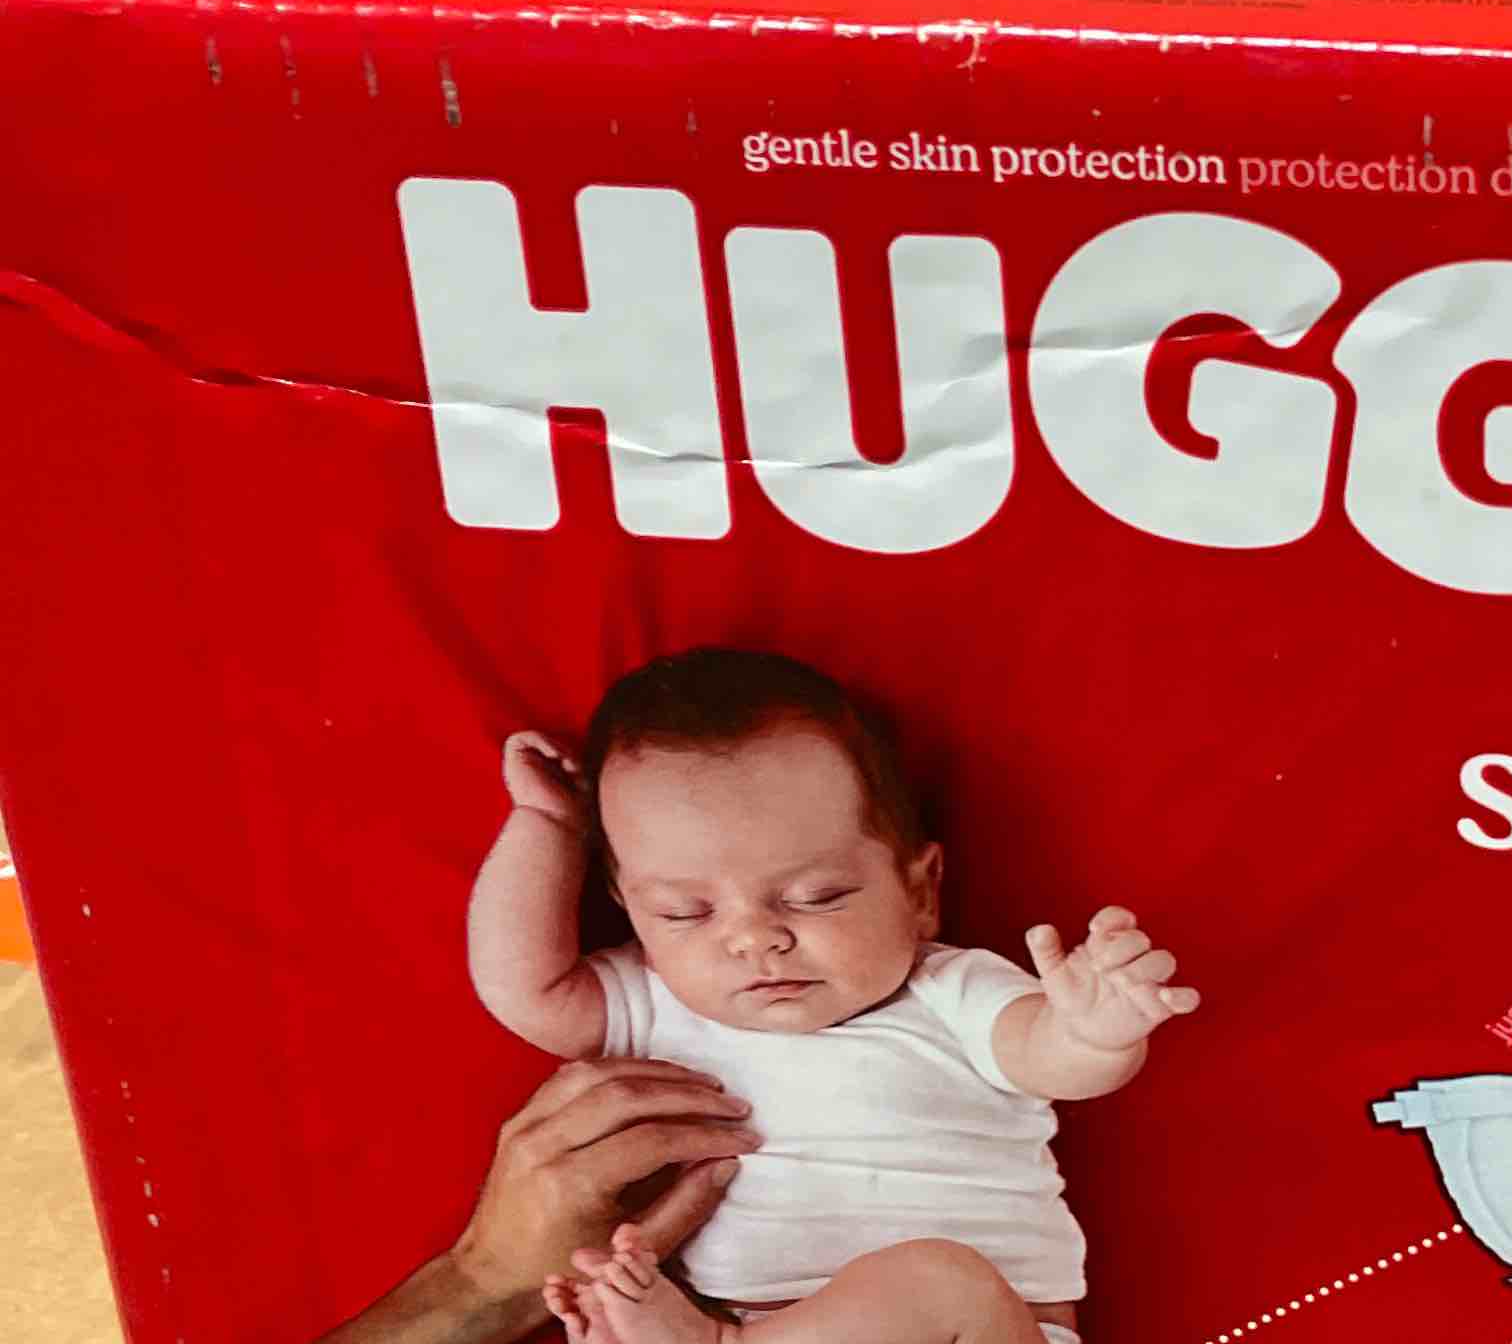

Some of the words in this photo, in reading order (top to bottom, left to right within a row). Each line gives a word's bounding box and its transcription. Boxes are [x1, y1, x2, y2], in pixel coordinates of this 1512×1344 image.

[742, 130, 878, 173] gentle
[888, 132, 980, 174] skin
[991, 143, 1227, 184] protection
[1239, 153, 1477, 194] protection
